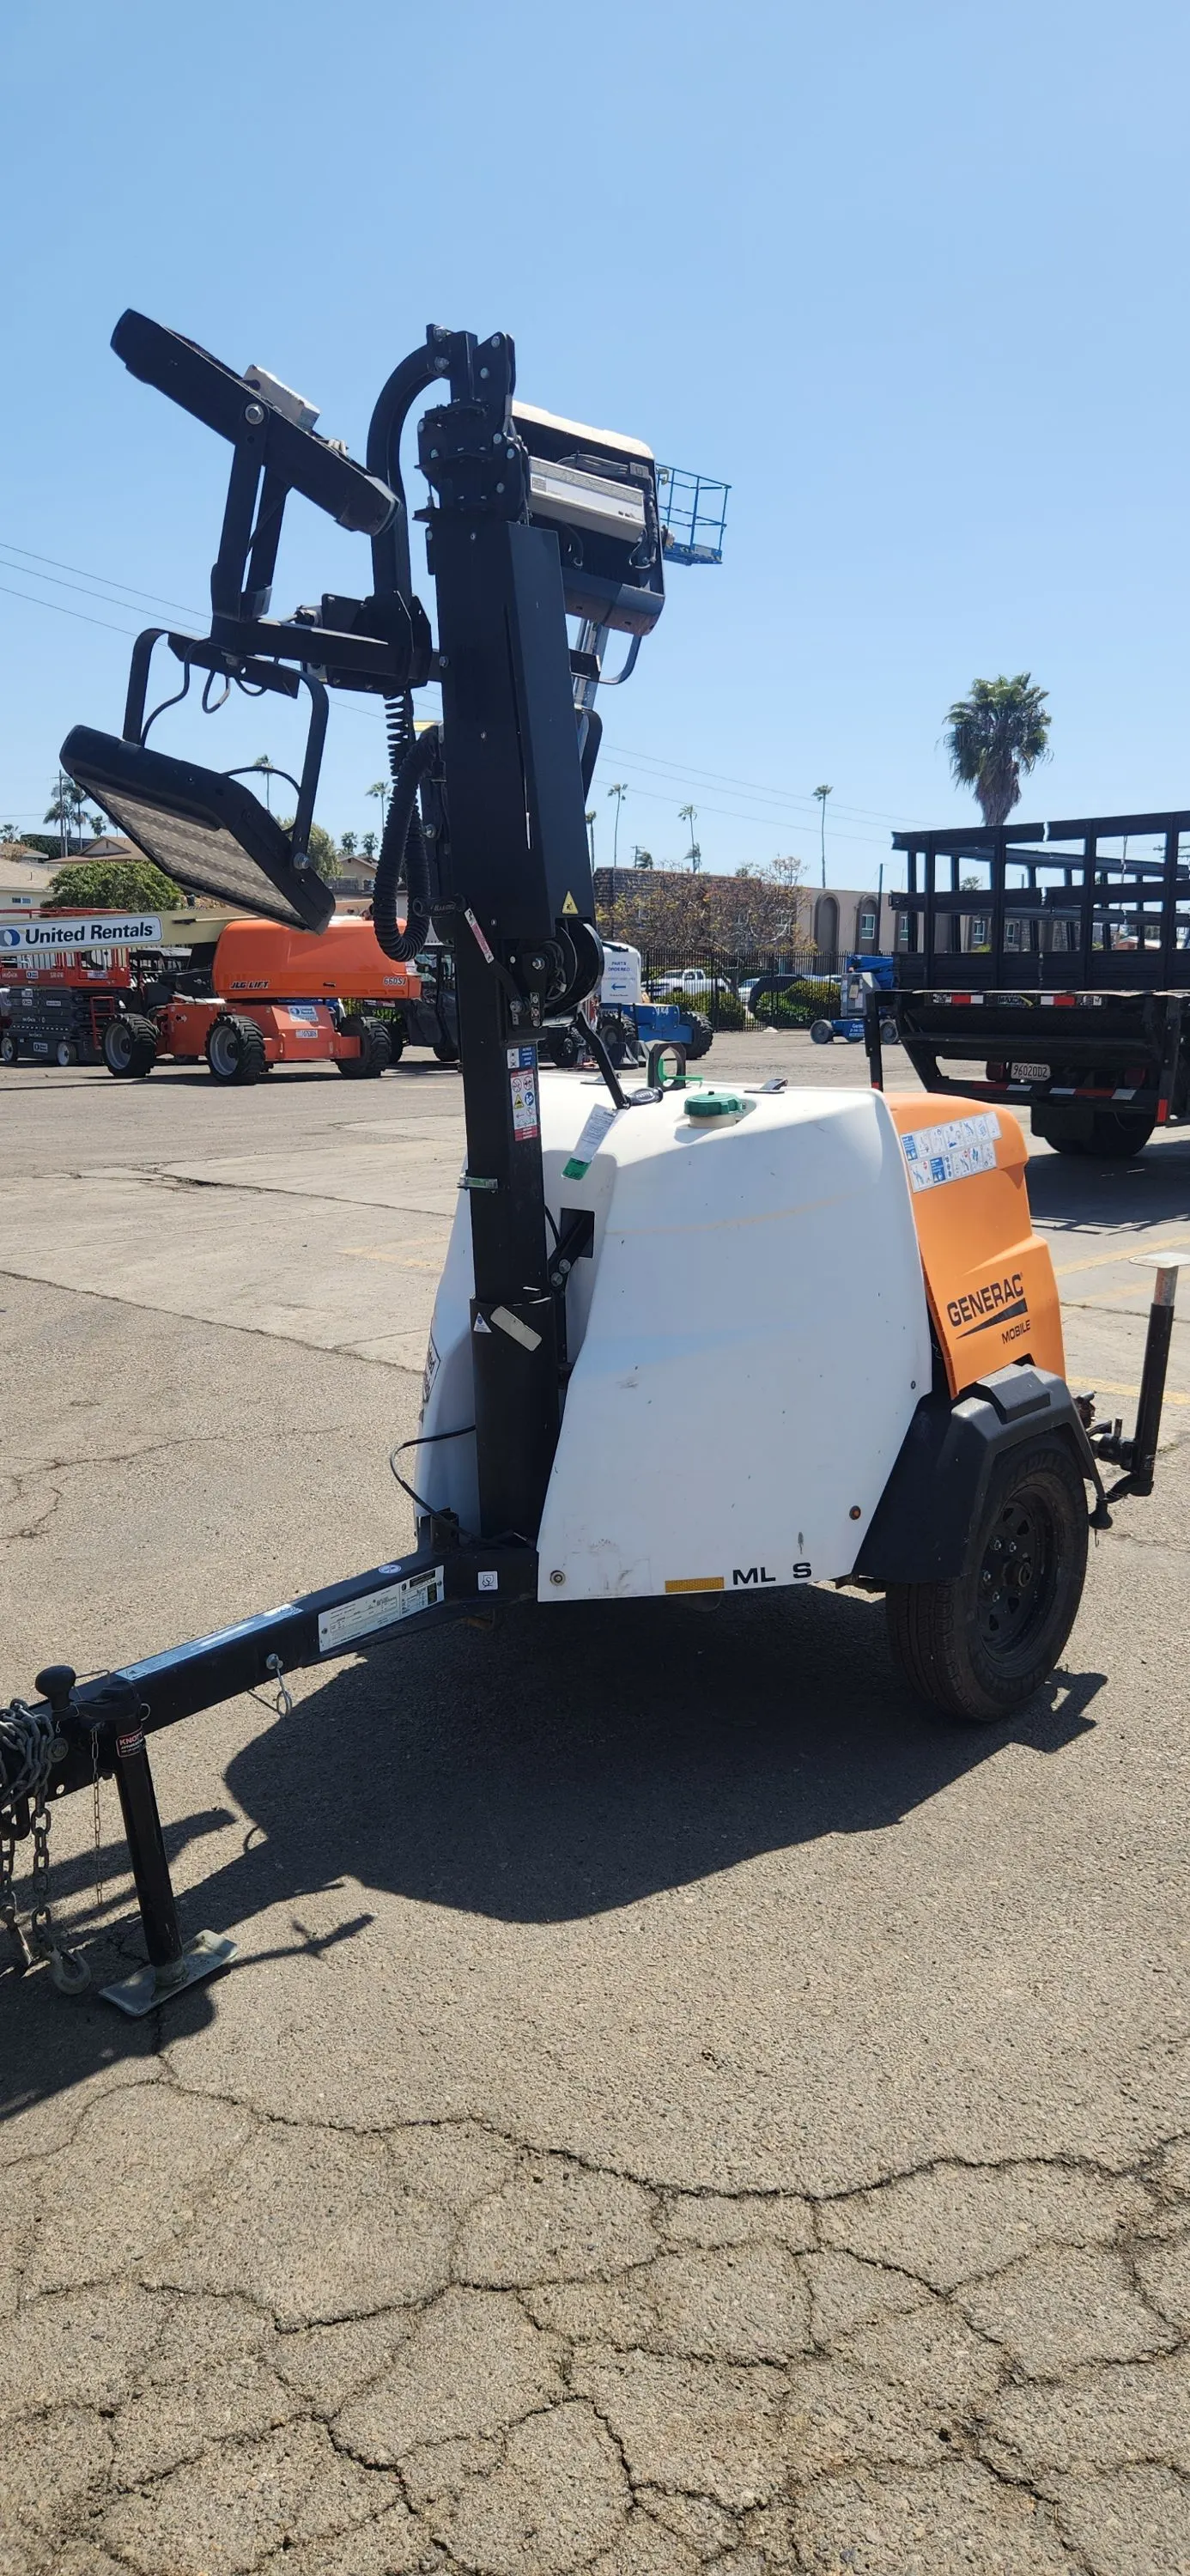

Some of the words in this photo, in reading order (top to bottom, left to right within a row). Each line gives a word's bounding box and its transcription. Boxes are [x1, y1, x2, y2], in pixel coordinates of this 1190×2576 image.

[25, 926, 85, 945] United
[90, 922, 154, 940] Rentals
[229, 981, 247, 990] JLG
[248, 981, 270, 989] LIFT
[946, 1273, 1024, 1327] GENERAC
[1001, 1319, 1031, 1345] MOBILE
[732, 1567, 776, 1586] ML
[792, 1562, 812, 1579] S
